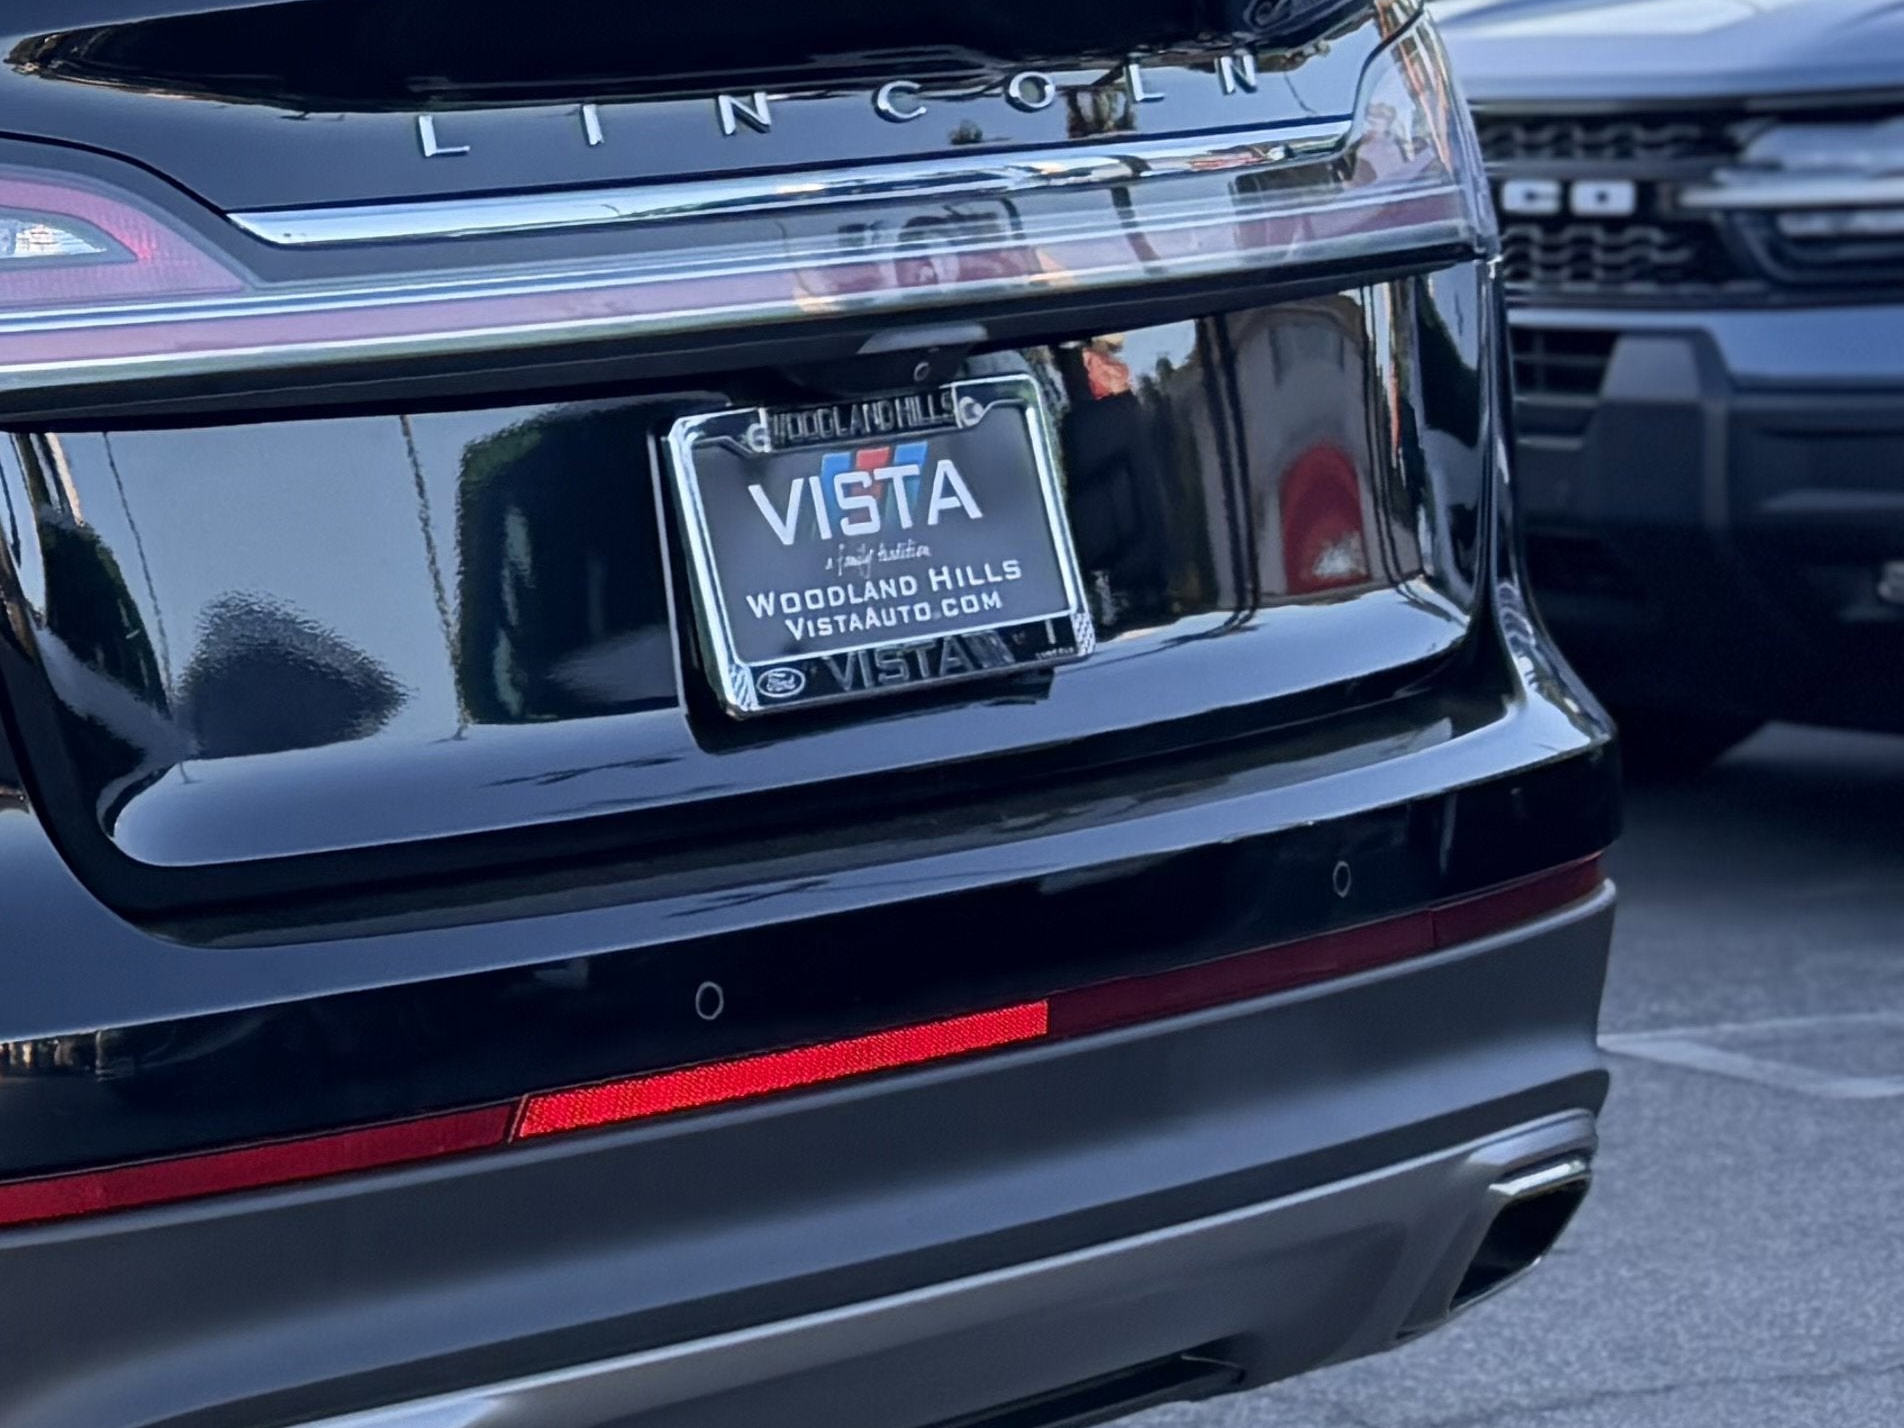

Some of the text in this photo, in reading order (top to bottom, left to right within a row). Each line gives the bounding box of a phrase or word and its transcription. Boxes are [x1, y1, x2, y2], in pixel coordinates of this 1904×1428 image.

[415, 52, 1259, 160] LINCOLN
[748, 458, 984, 546] VISTA
[821, 635, 977, 694] VISTA
